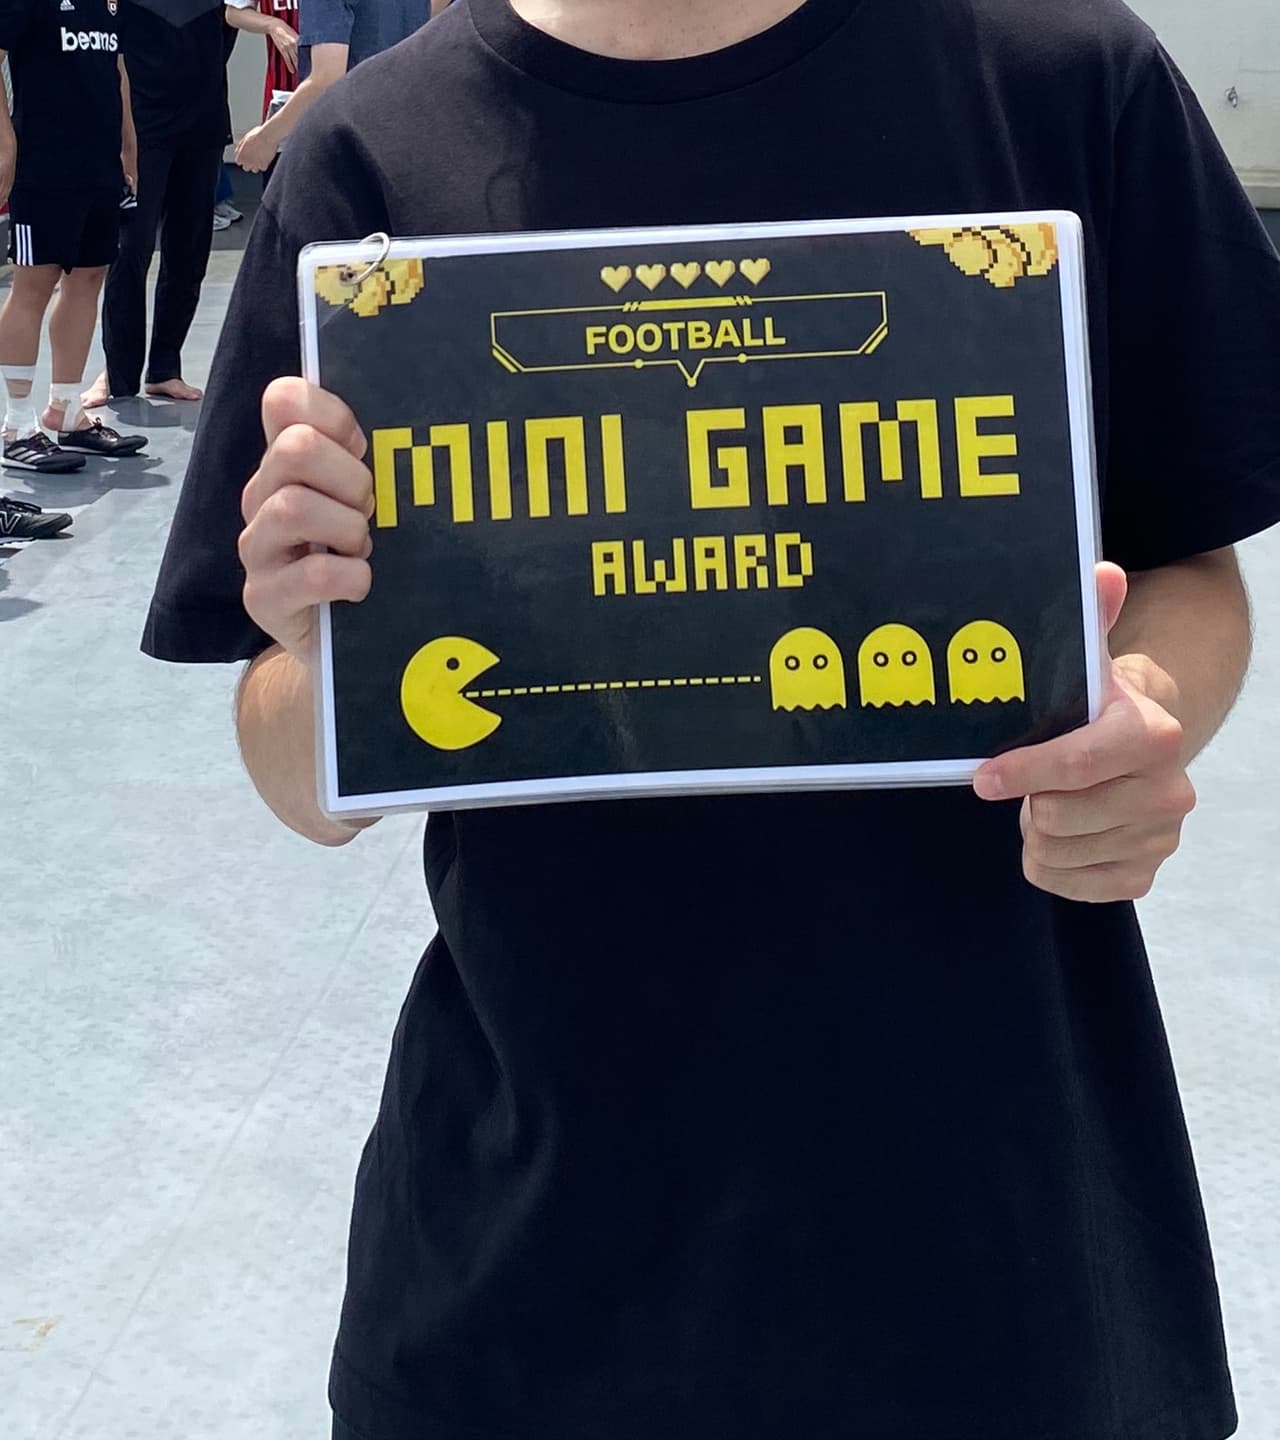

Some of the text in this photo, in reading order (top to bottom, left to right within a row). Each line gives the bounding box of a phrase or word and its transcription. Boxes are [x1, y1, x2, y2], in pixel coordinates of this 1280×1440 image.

[585, 317, 787, 355] FOOTBALL
[372, 394, 1020, 528] MINI GAME
[592, 532, 813, 597] AWARD
